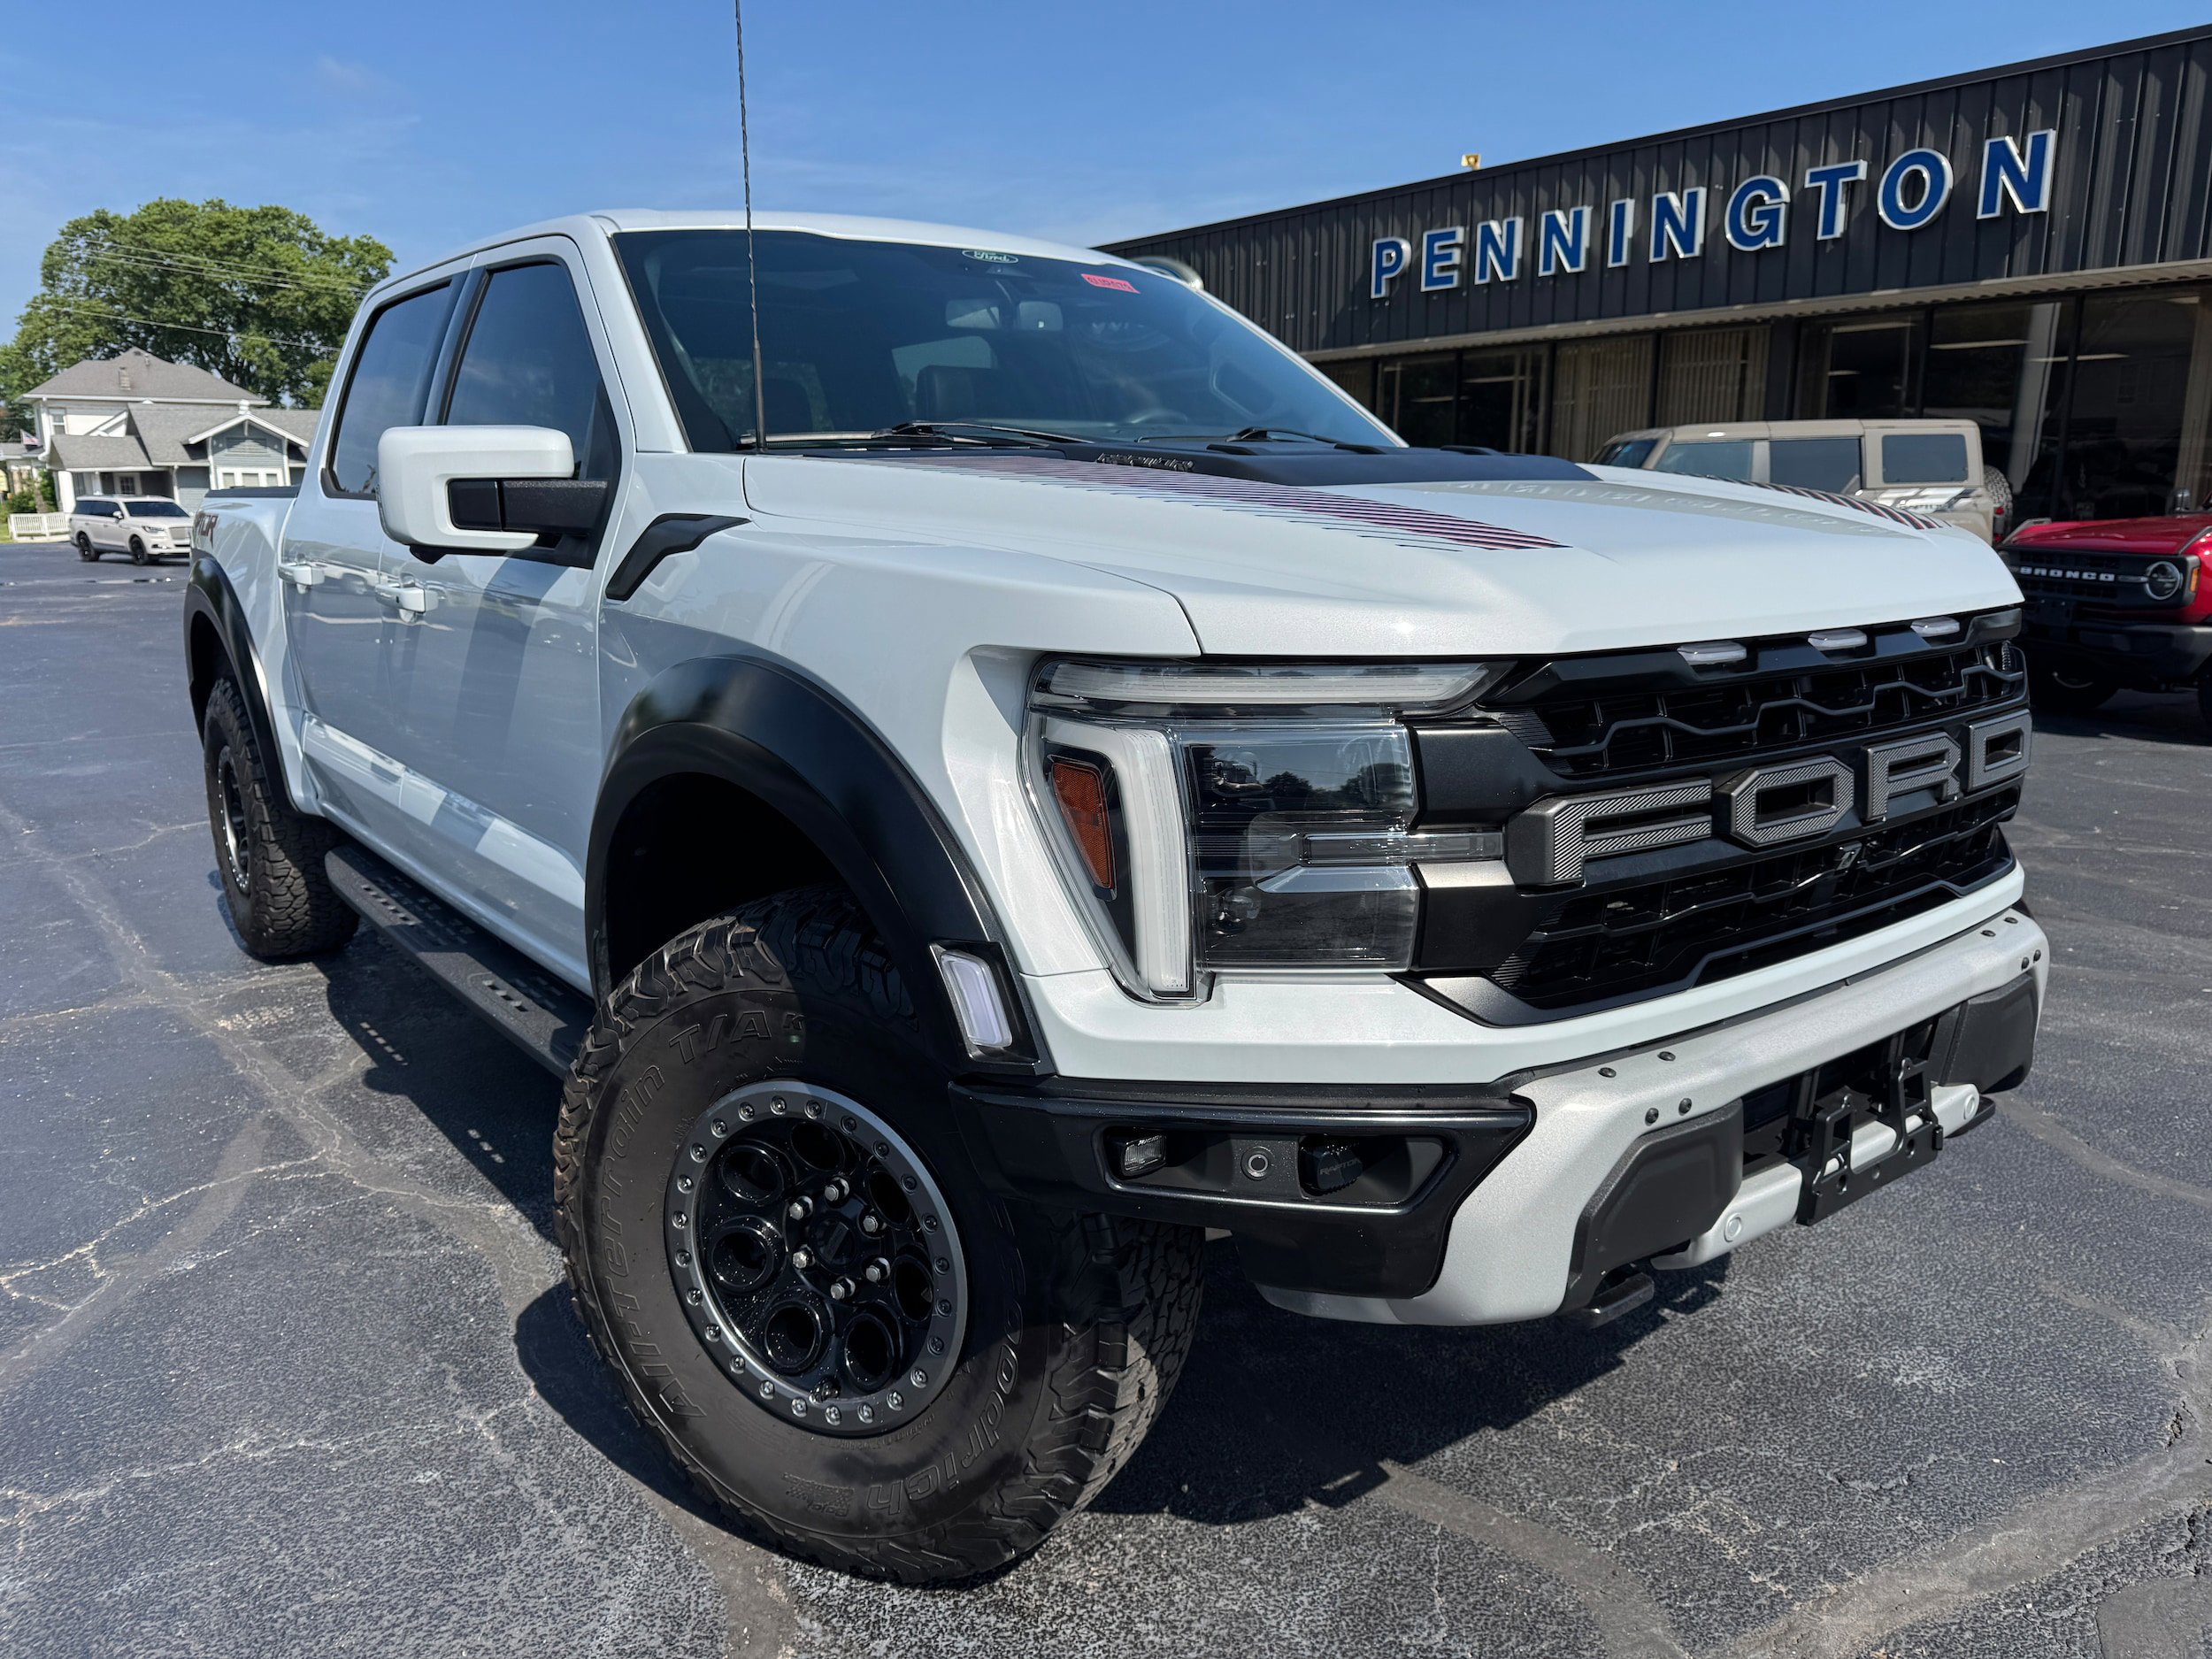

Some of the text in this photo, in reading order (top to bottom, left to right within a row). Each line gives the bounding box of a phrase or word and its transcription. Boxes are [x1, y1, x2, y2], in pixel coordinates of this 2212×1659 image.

[1371, 129, 2056, 299] PENNINGTON
[2020, 566, 2115, 582] BRONCO
[1511, 709, 2032, 884] FORD
